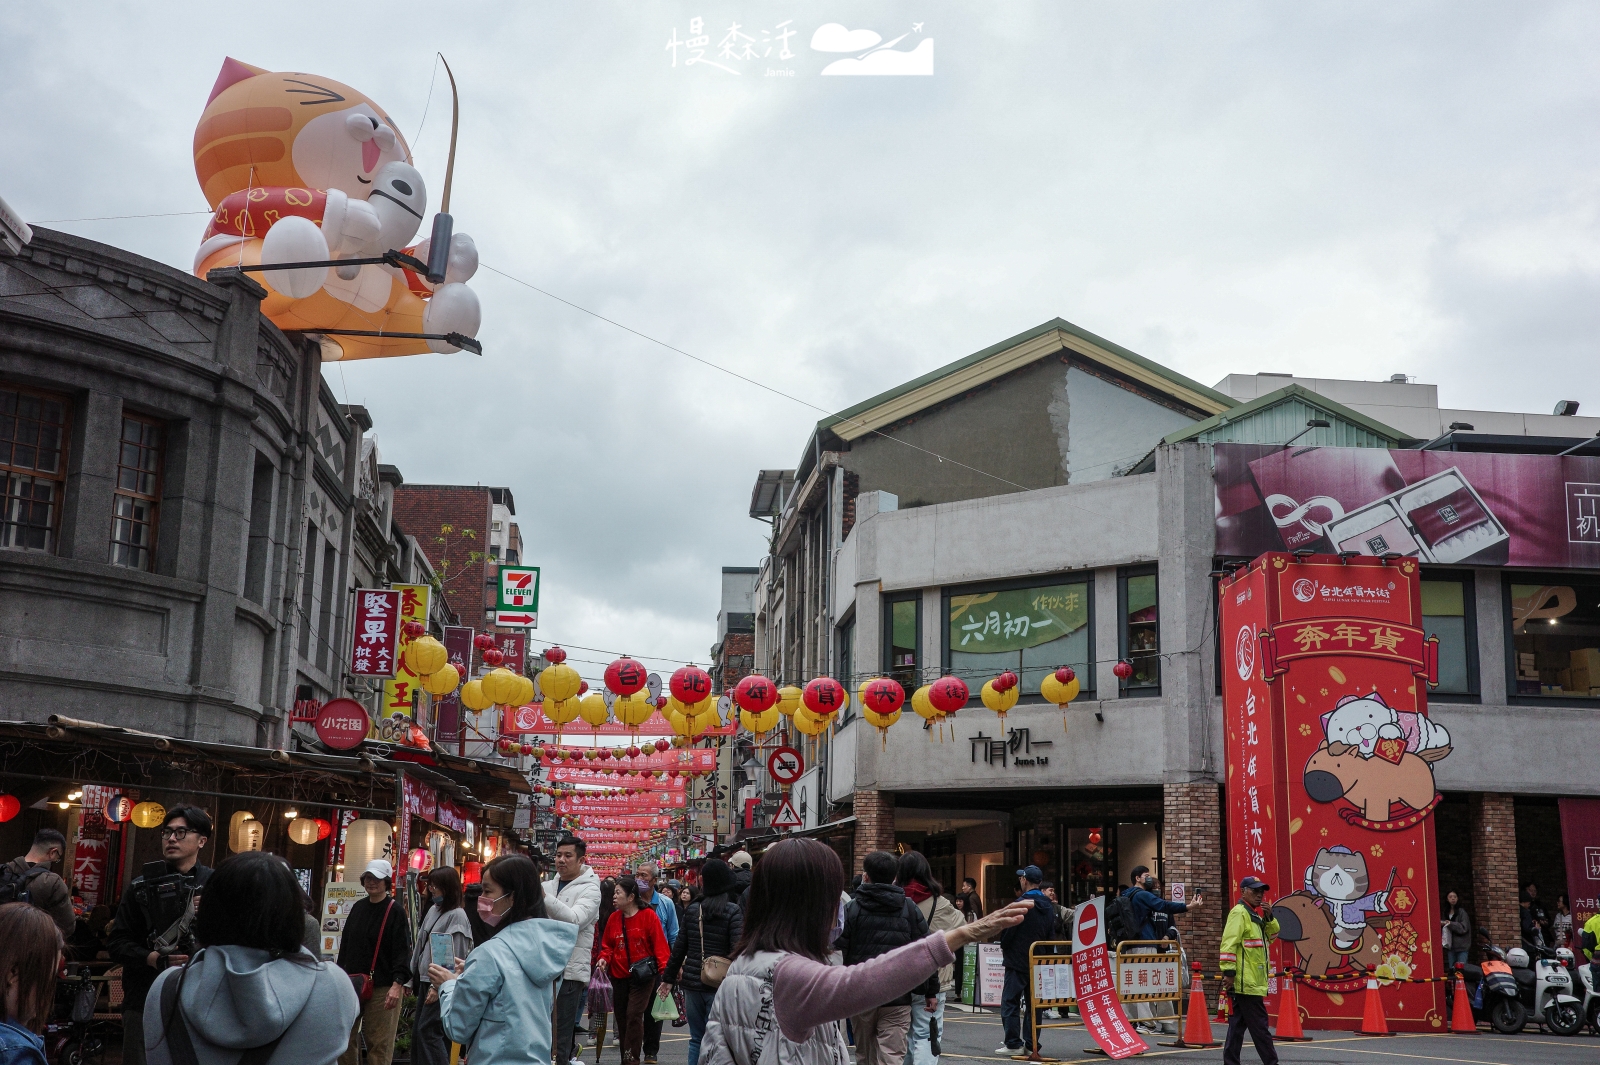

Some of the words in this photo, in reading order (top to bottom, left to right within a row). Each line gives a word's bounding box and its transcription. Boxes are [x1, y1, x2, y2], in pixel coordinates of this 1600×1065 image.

[507, 573, 532, 606] 7
[1320, 584, 1390, 599] 台北年貨大街
[360, 592, 392, 645] 堅果
[960, 611, 1052, 645] 六月初一
[389, 588, 422, 707] 香大王
[1293, 623, 1404, 654] 奔年貨
[354, 646, 372, 673] 批發
[375, 647, 392, 673] 大王
[617, 664, 641, 686] 台
[683, 674, 705, 694] 北
[746, 683, 768, 704] 年
[814, 683, 835, 706] 貨
[874, 686, 897, 704] 大
[322, 716, 362, 731] 小花園
[969, 726, 1053, 767] 六月初一
[1014, 756, 1034, 766] June
[1245, 687, 1266, 874] 台北年貨大街
[1394, 889, 1412, 910] 春
[1076, 952, 1088, 963] 1/28
[1092, 947, 1104, 958] 1/30
[1079, 974, 1091, 985] 1/31
[1094, 968, 1107, 979] 2/15
[1124, 968, 1175, 987] 車輛改道
[1085, 999, 1120, 1050] 車輛禁入
[1101, 994, 1135, 1045] 年貨期間
